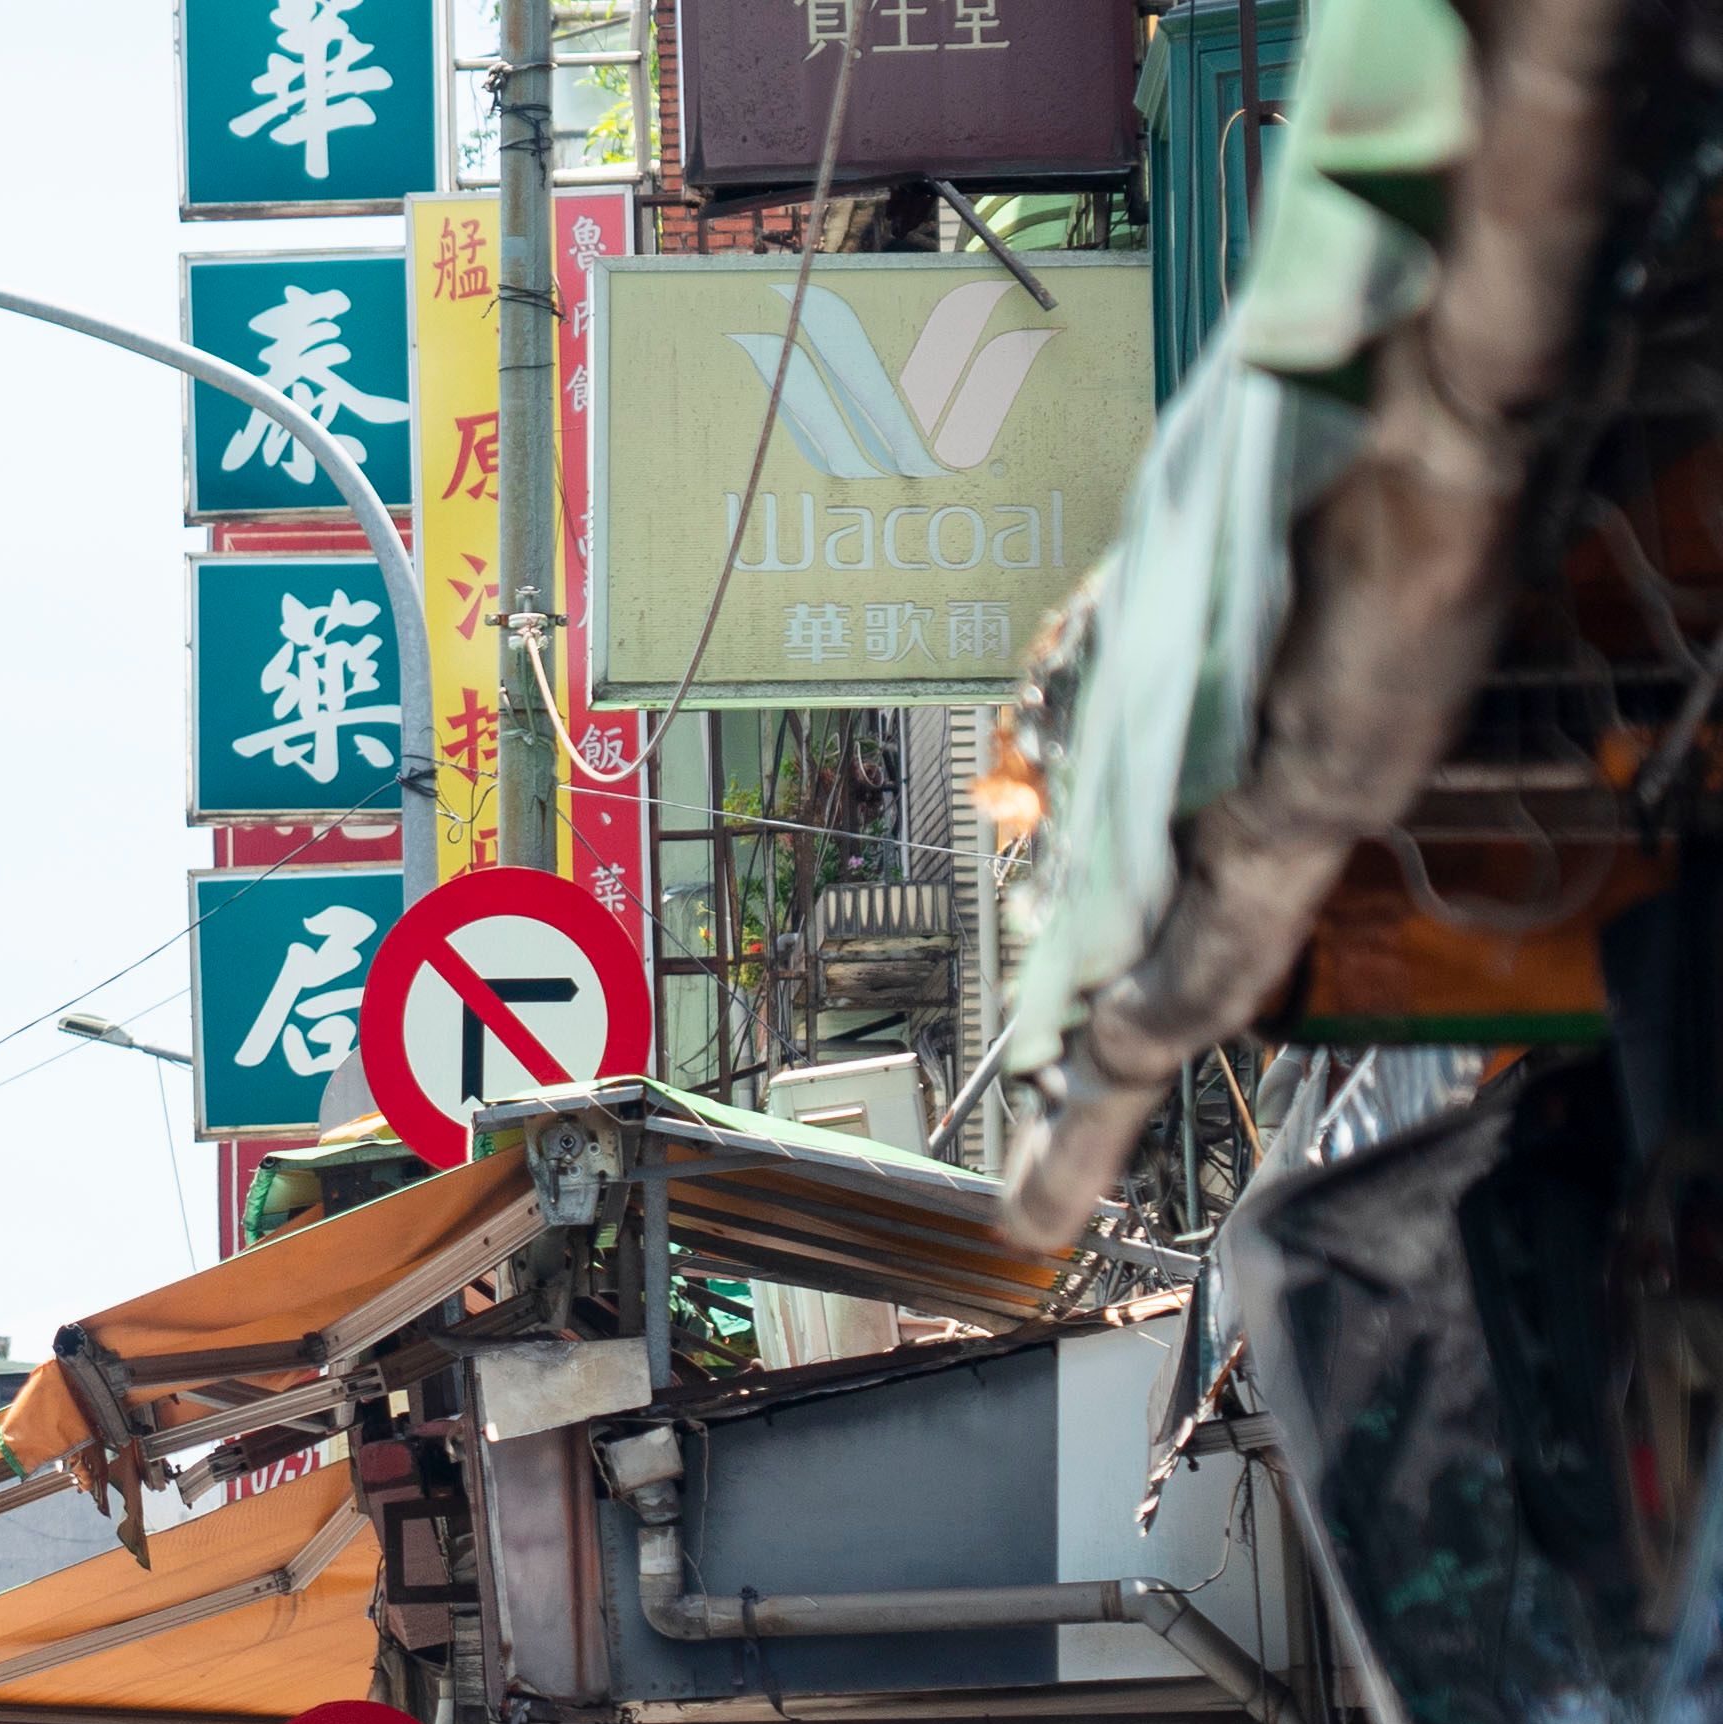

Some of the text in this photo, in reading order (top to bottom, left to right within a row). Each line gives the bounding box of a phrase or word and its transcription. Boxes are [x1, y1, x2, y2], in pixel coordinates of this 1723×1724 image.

[723, 491, 1064, 573] Wacoal
[782, 601, 1012, 666] 華歌爾
